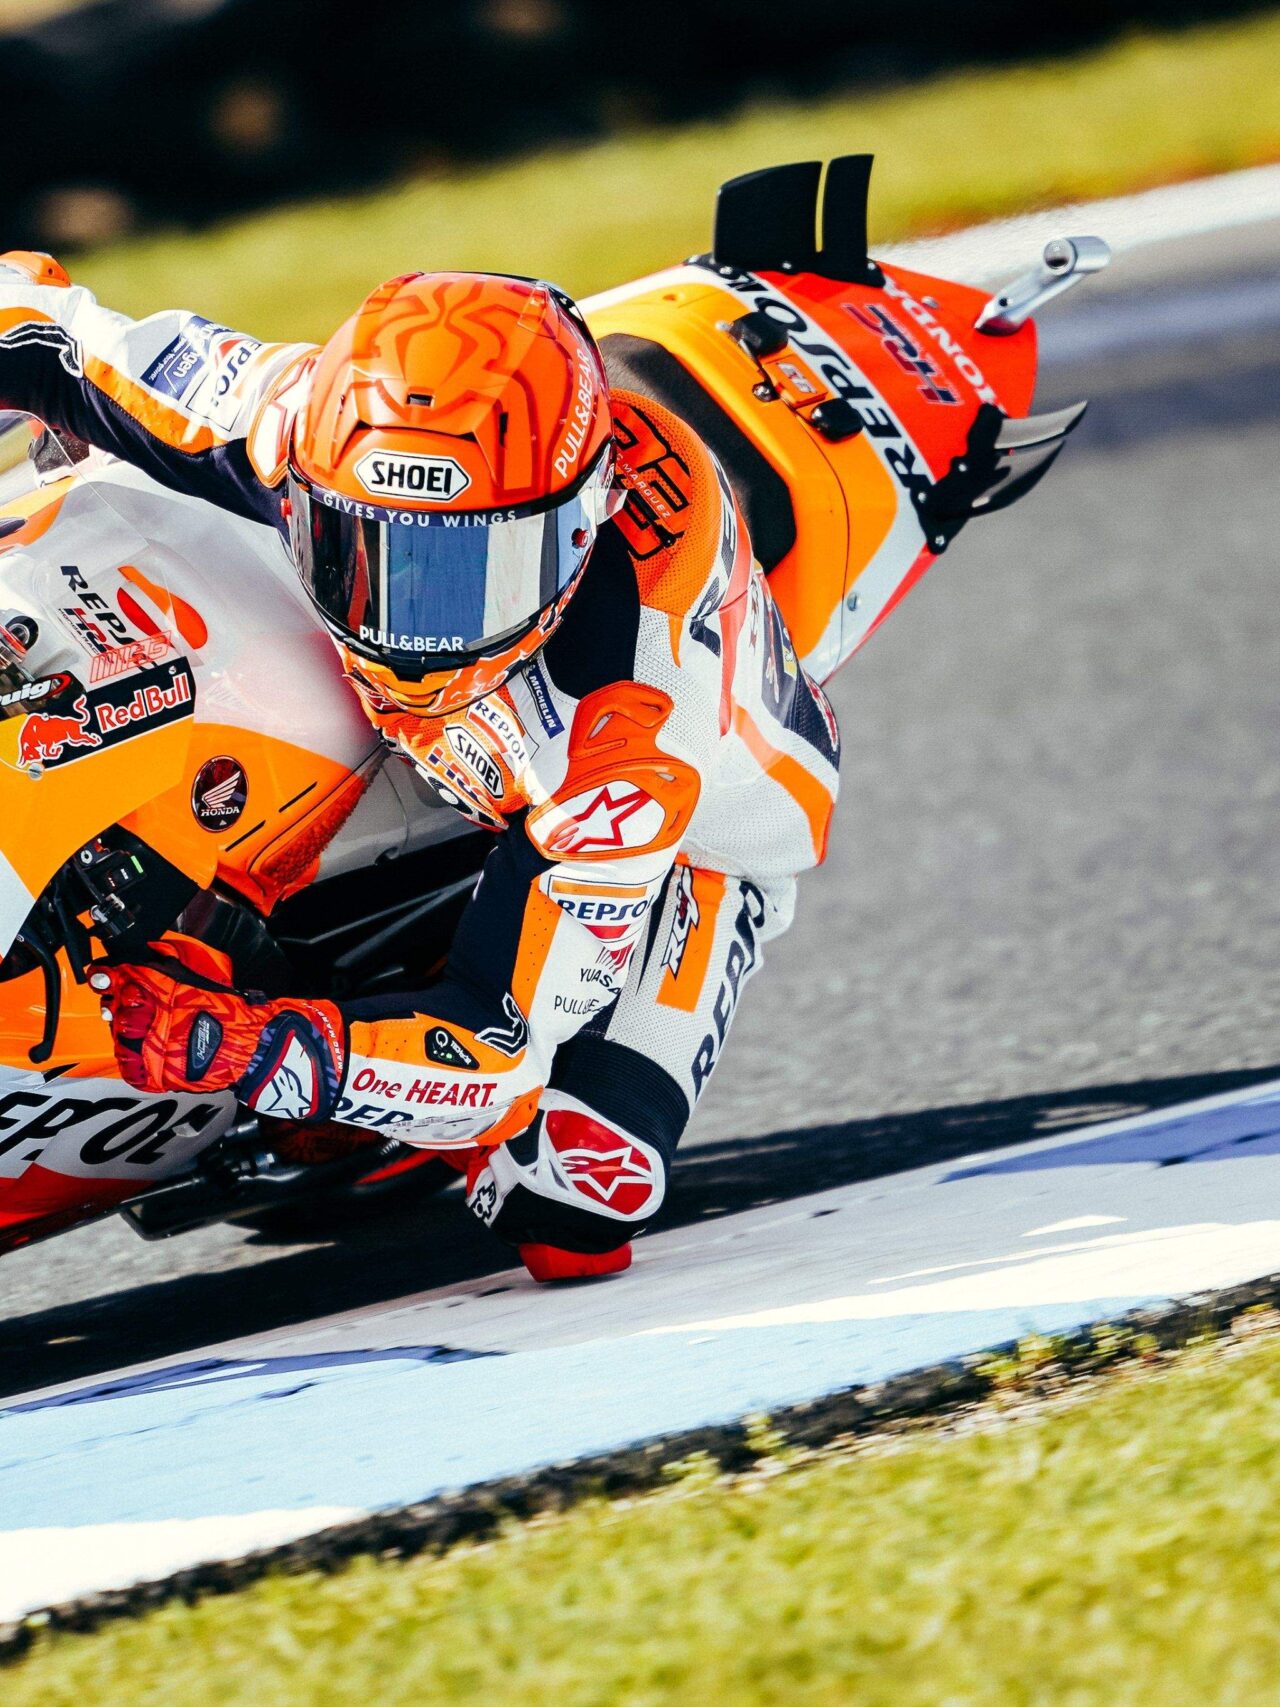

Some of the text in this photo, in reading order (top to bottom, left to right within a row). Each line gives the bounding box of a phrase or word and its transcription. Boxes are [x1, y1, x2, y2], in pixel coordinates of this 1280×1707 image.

[728, 272, 934, 490] REPSOL
[554, 348, 593, 479] PULL&BEAR
[370, 458, 453, 494] SHOEI
[622, 462, 672, 519] MARQUEZ
[323, 493, 517, 528] GIVES YOU WINGS
[359, 624, 464, 652] PULL&BEAR
[529, 674, 558, 730] MICHELIN
[474, 701, 531, 763] REPSOL
[454, 733, 500, 793] SHOEI
[201, 805, 240, 817] HONDA
[557, 894, 653, 922] REPSO
[580, 967, 622, 995] YUASA
[691, 880, 765, 1104] REPSO
[352, 1067, 498, 1108] One HEART.
